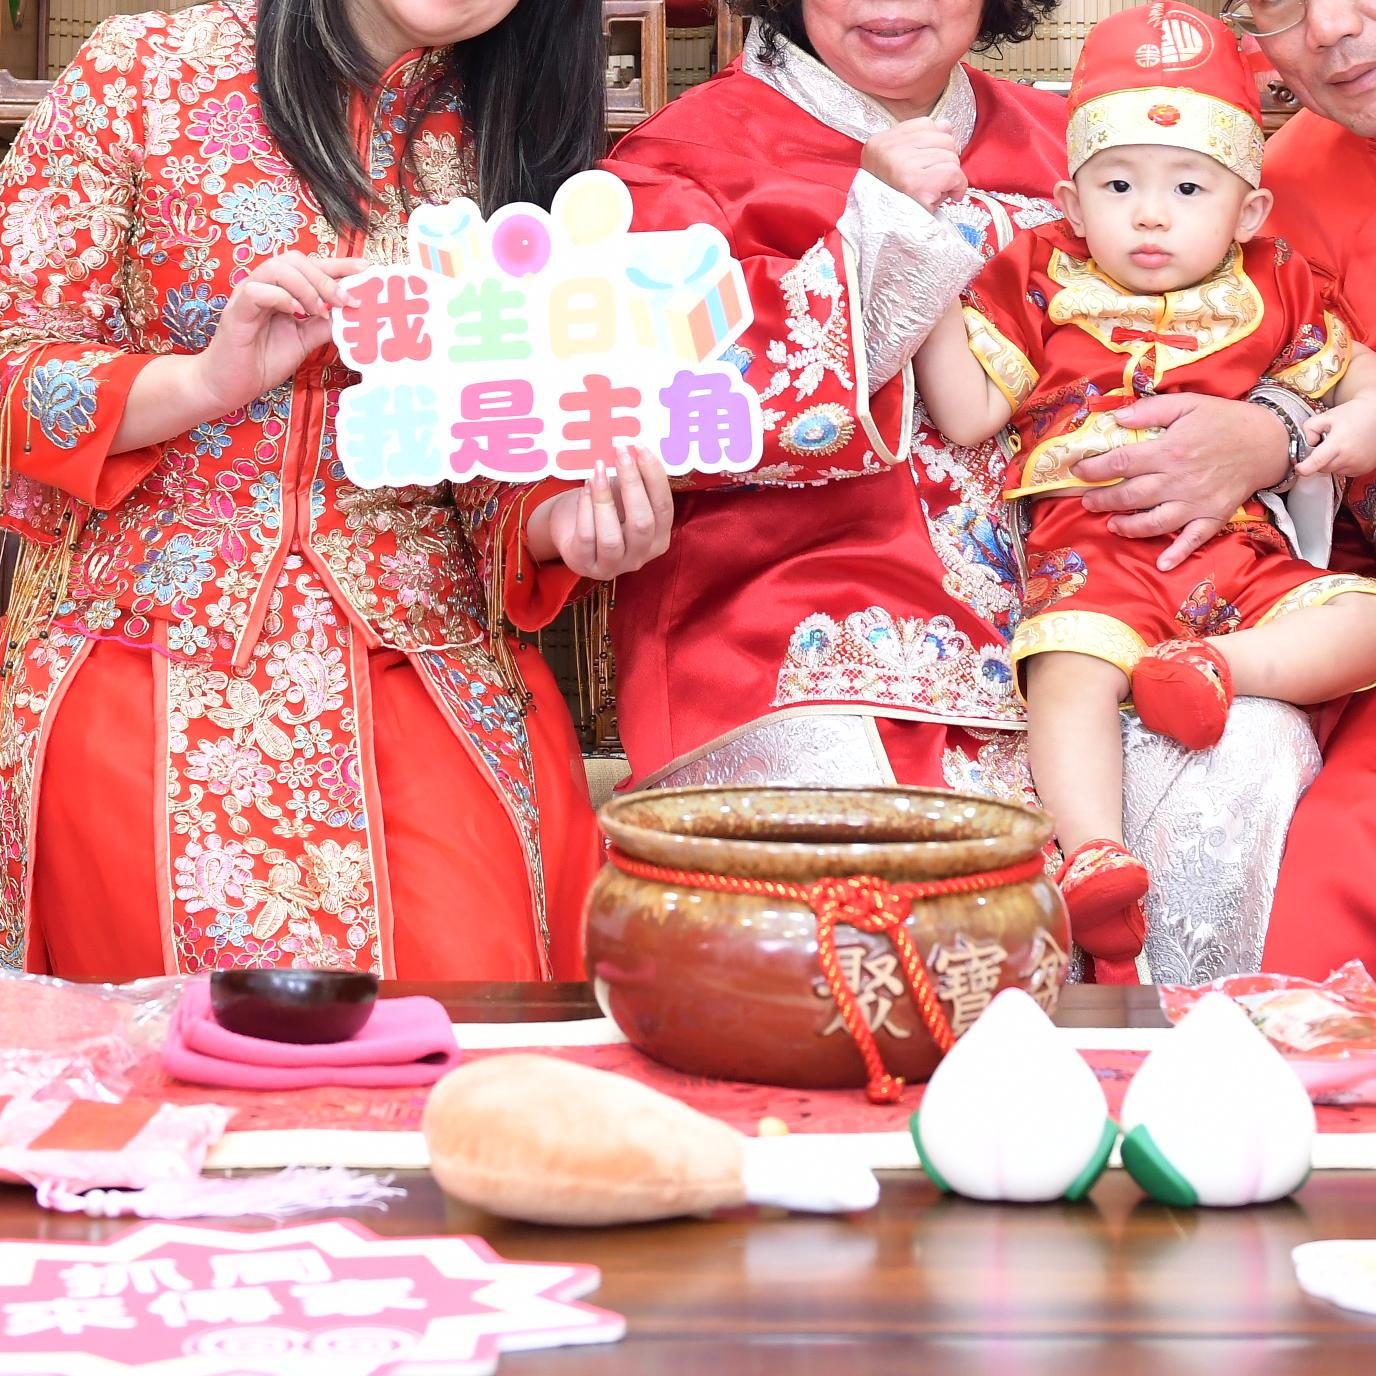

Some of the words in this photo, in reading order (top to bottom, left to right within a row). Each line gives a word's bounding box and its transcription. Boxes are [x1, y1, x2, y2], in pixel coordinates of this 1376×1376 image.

[342, 274, 619, 365] 我生日
[344, 370, 753, 482] 我是主角
